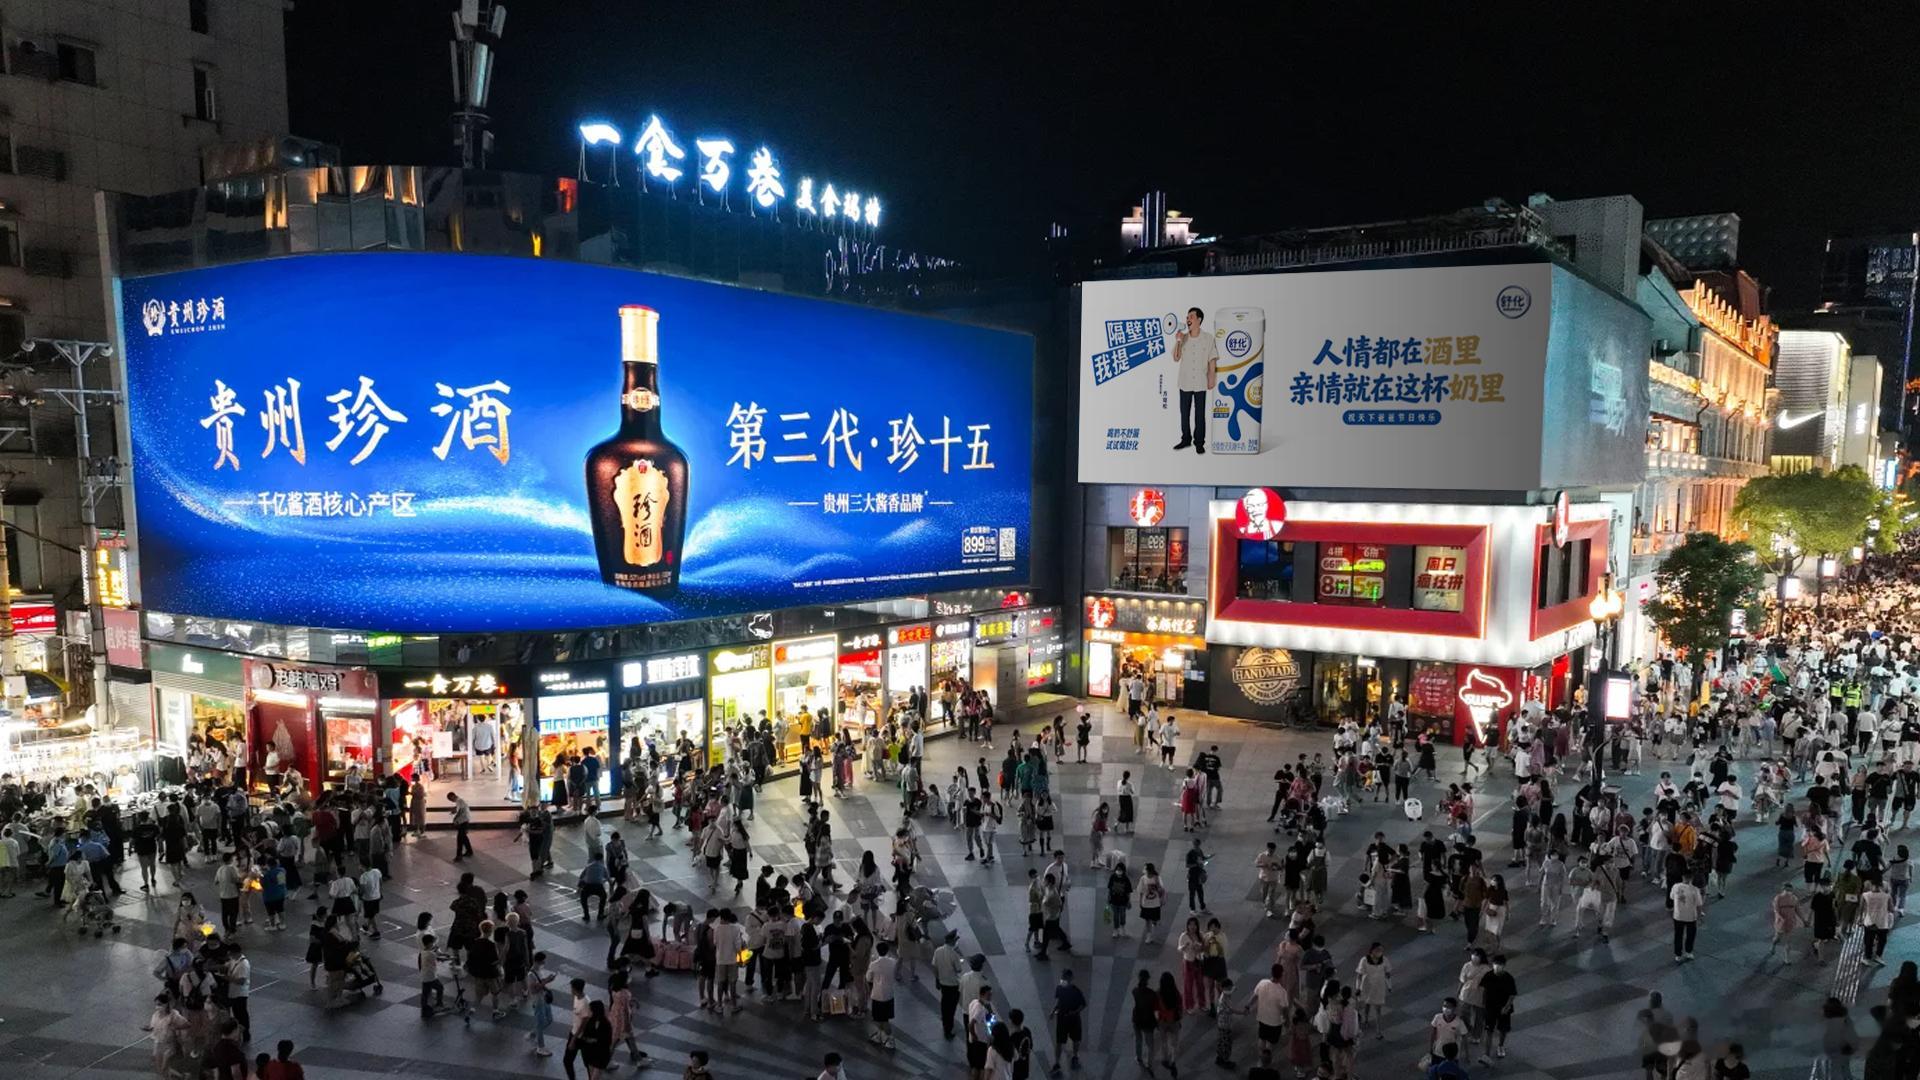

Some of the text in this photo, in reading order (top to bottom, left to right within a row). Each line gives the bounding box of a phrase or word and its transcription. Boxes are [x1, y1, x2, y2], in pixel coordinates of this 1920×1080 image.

[167, 296, 225, 327] 贵州珍酒
[1500, 295, 1525, 308] 舒化
[1107, 319, 1161, 347] 隔壁的
[1228, 338, 1247, 349] 舒化
[1095, 338, 1164, 383] 我提一杯
[1312, 334, 1483, 369] 人情都在酒里
[1289, 371, 1505, 406] 亲情就在这杯奶里
[200, 375, 512, 471] 贵州珍酒
[725, 401, 995, 474] 第三代·珍十五
[258, 491, 417, 517] 千亿酱酒核心产区
[632, 491, 658, 548] 珍酒
[964, 535, 986, 553] 899
[1426, 557, 1457, 571] 周日
[404, 674, 500, 695] 一食万巷
[1235, 665, 1298, 681] HANDMADE
